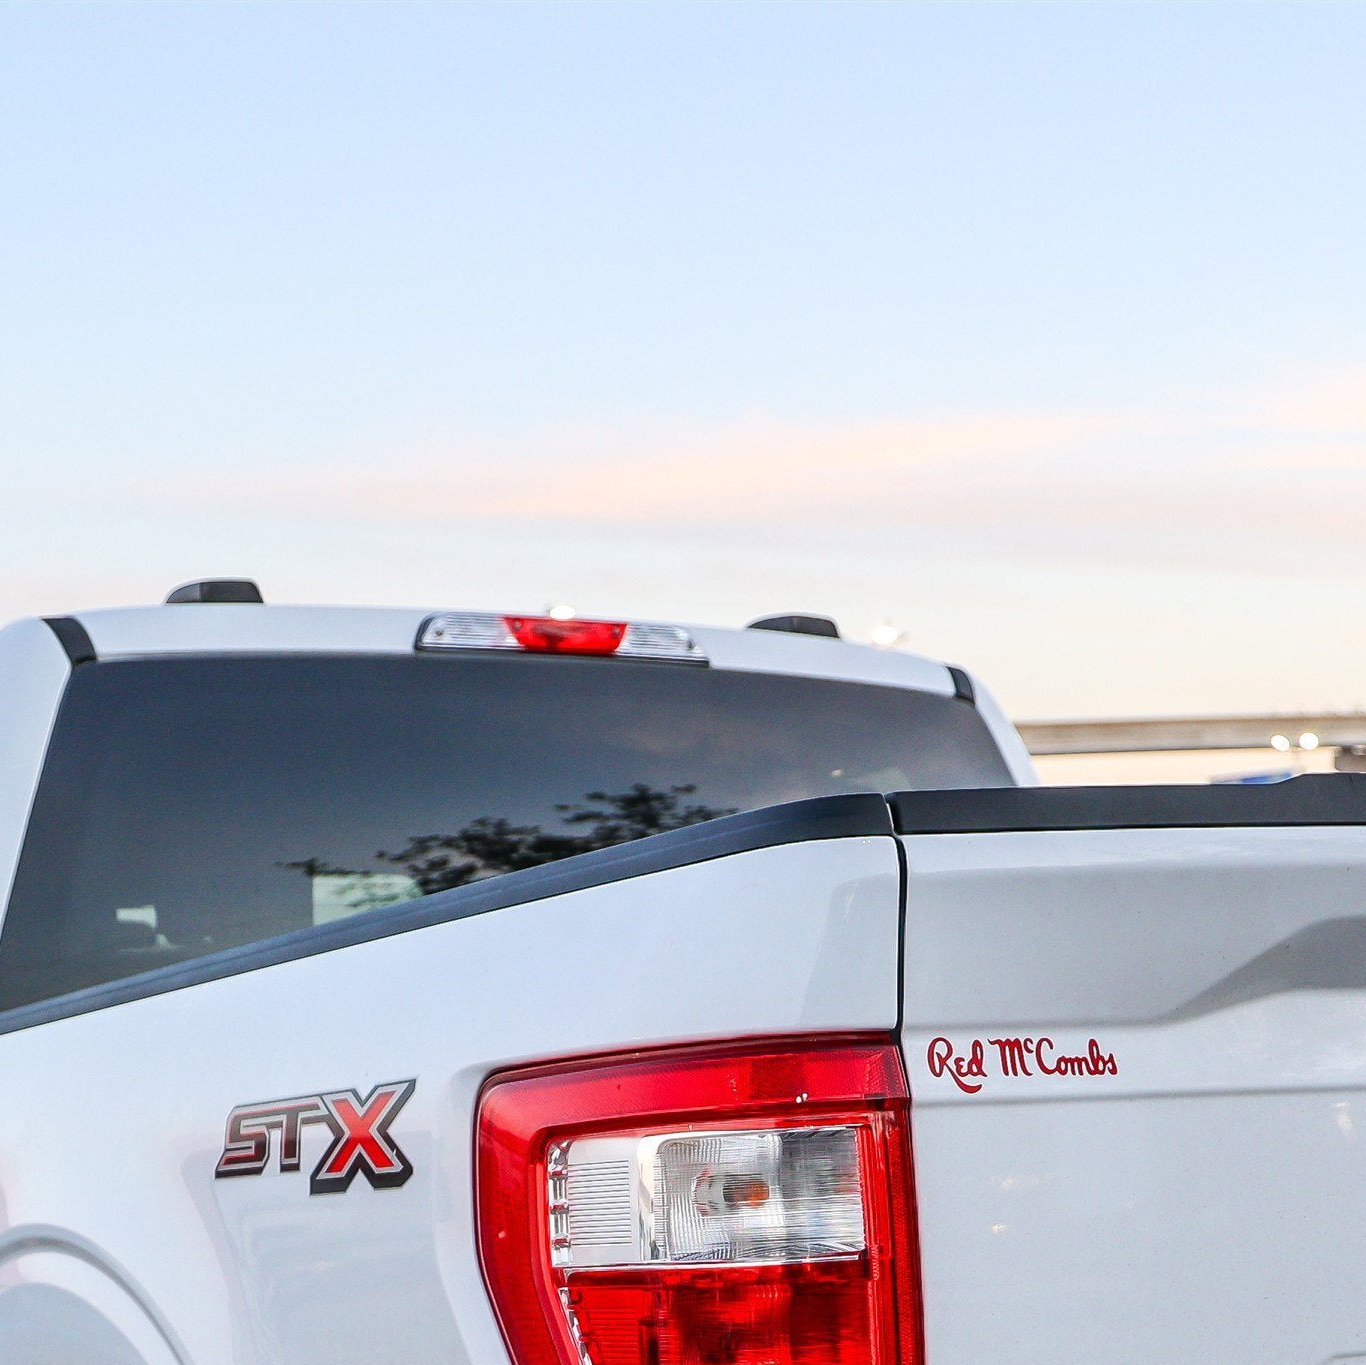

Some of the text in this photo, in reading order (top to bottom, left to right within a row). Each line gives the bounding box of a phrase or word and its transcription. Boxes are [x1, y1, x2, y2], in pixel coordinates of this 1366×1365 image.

[927, 1037, 1118, 1093] Red McCombs
[215, 1078, 417, 1195] STX
